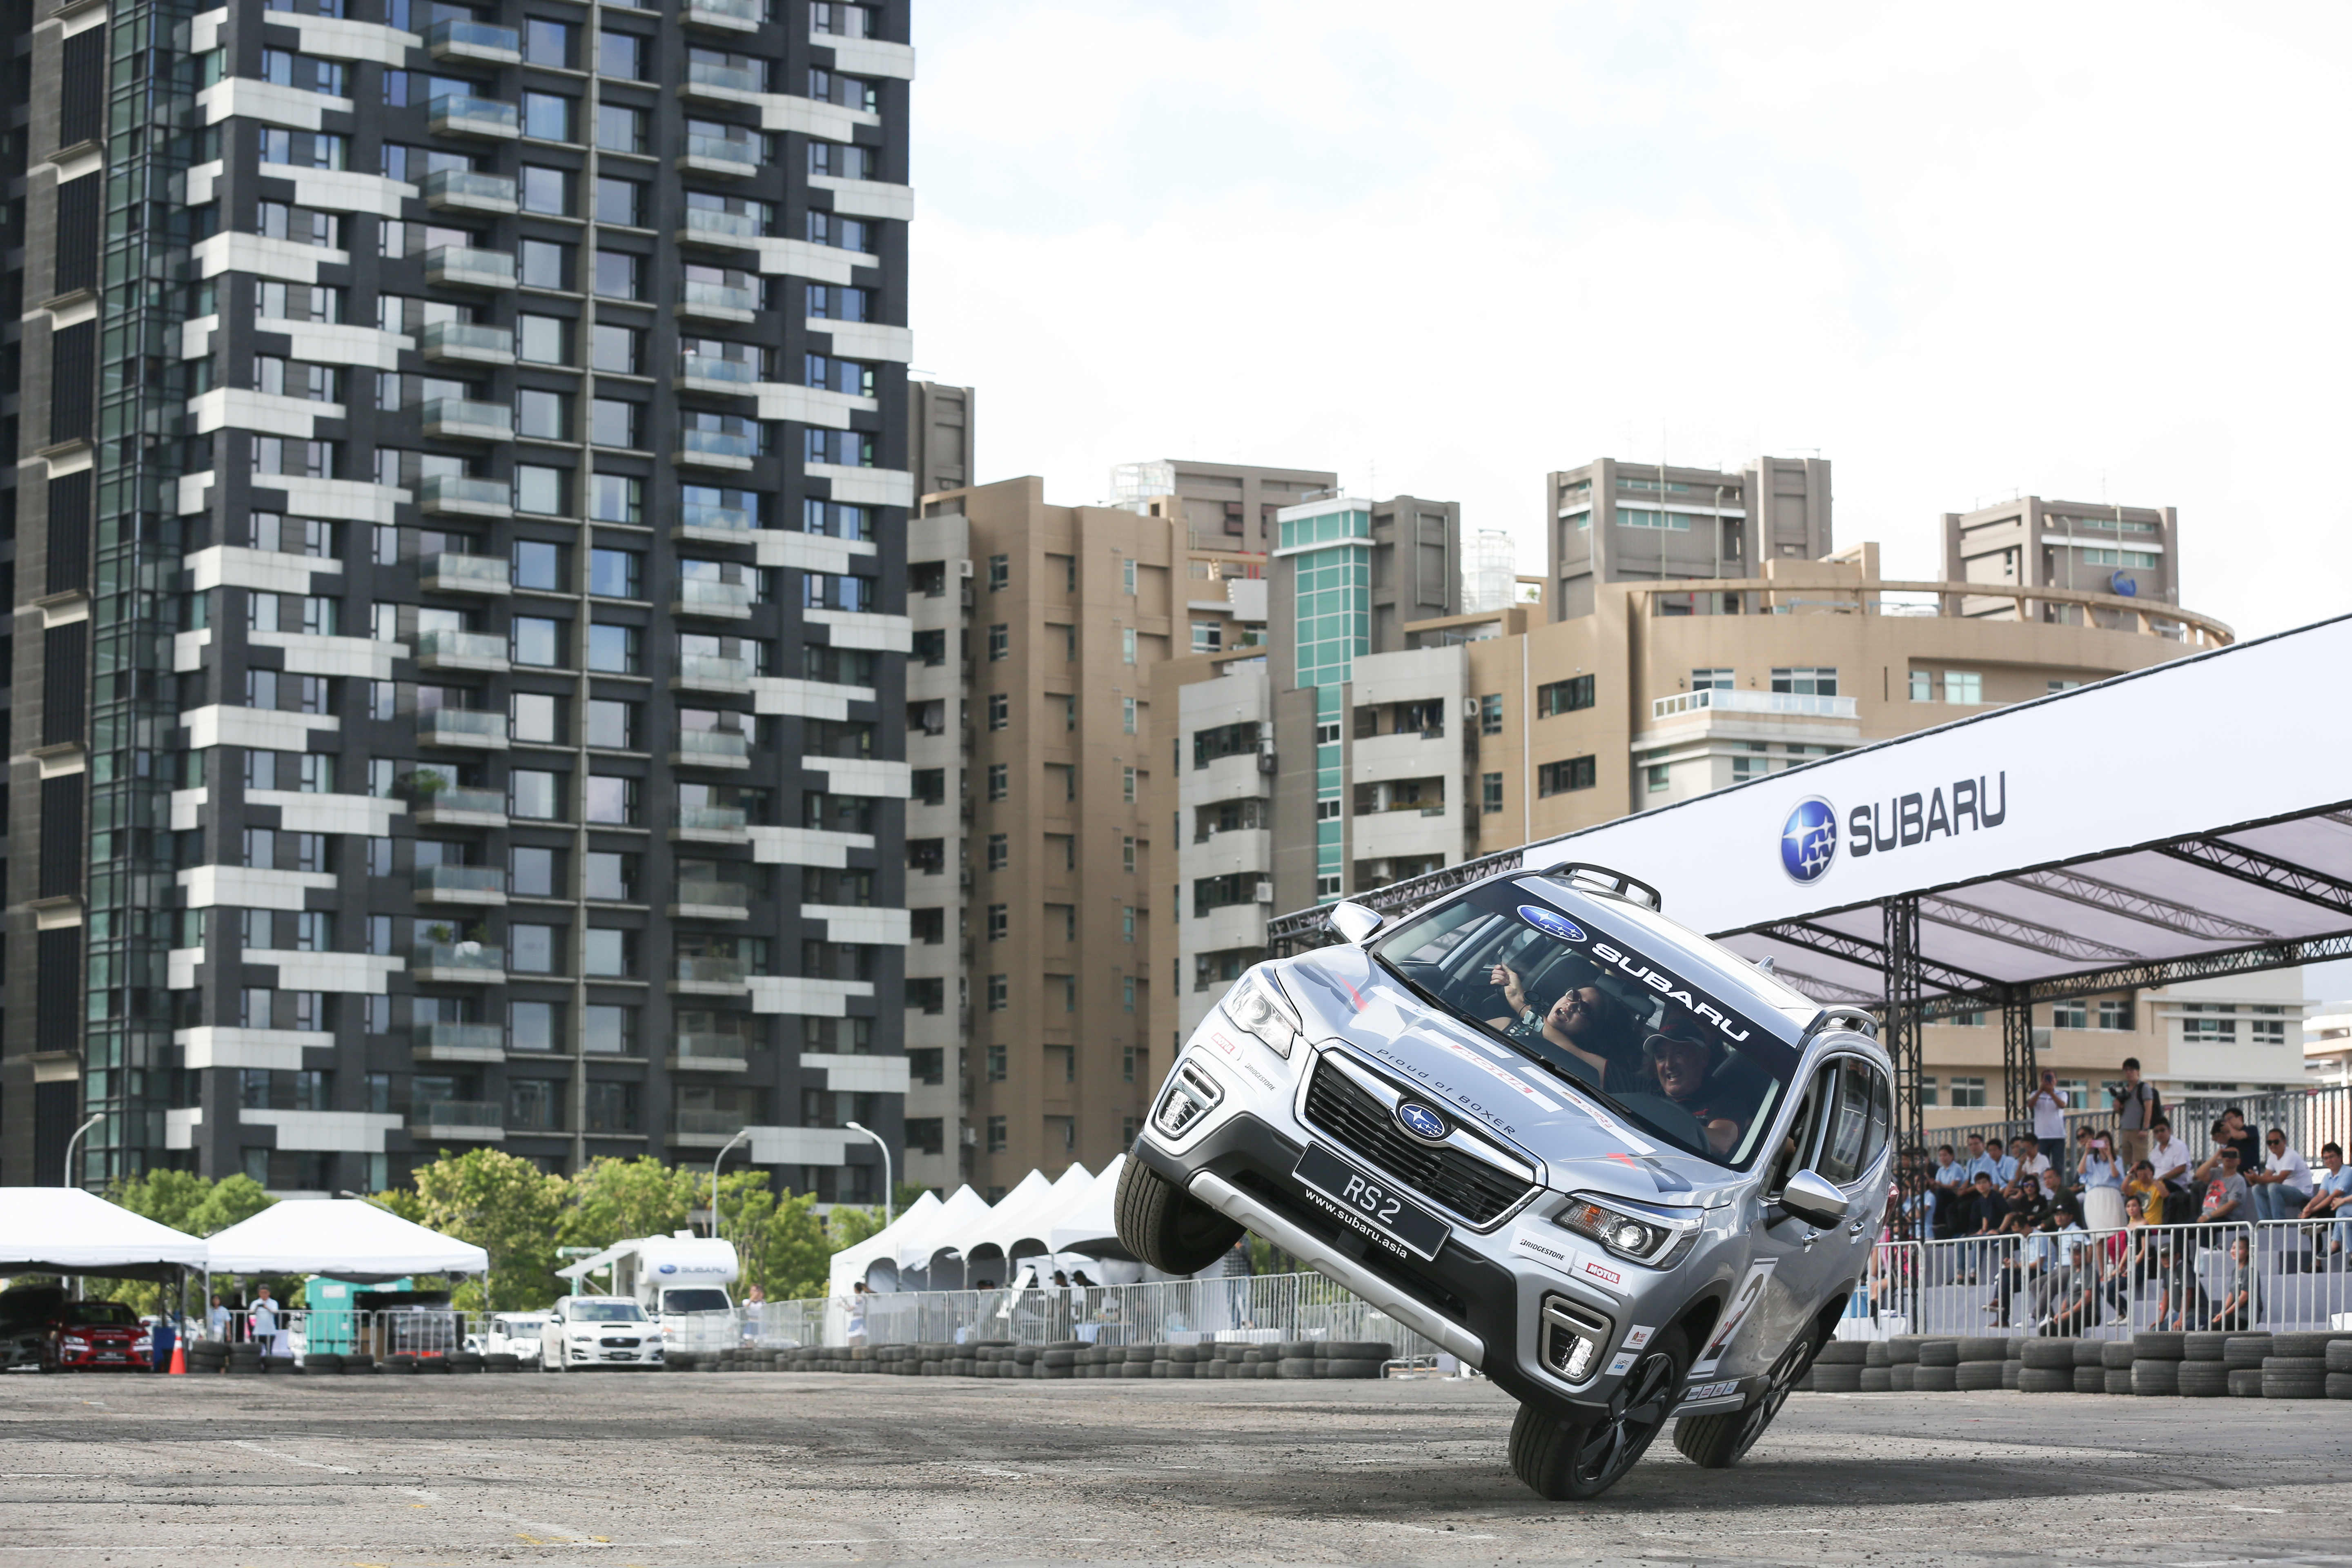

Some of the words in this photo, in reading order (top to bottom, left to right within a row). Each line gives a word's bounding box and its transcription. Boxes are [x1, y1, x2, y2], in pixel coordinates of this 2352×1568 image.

[1849, 771, 2005, 857] SUBARU
[1591, 943, 1750, 1042] SUBARU
[1213, 1033, 1234, 1053] MOTUL
[1245, 1063, 1276, 1091] BRIDGESTONE
[1376, 1049, 1429, 1078] Proud
[1435, 1082, 1453, 1092] of
[1458, 1095, 1515, 1134] BOXER
[1452, 1046, 1532, 1093] MOTUL
[1306, 1189, 1408, 1258] www.subaru.asia
[1336, 1200, 1364, 1219] Confidence
[1370, 1221, 1387, 1233] Motion
[1519, 1239, 1565, 1261] BRIDGESTONE
[1587, 1264, 1619, 1283] MOTUL
[1702, 1273, 1764, 1361] 2
